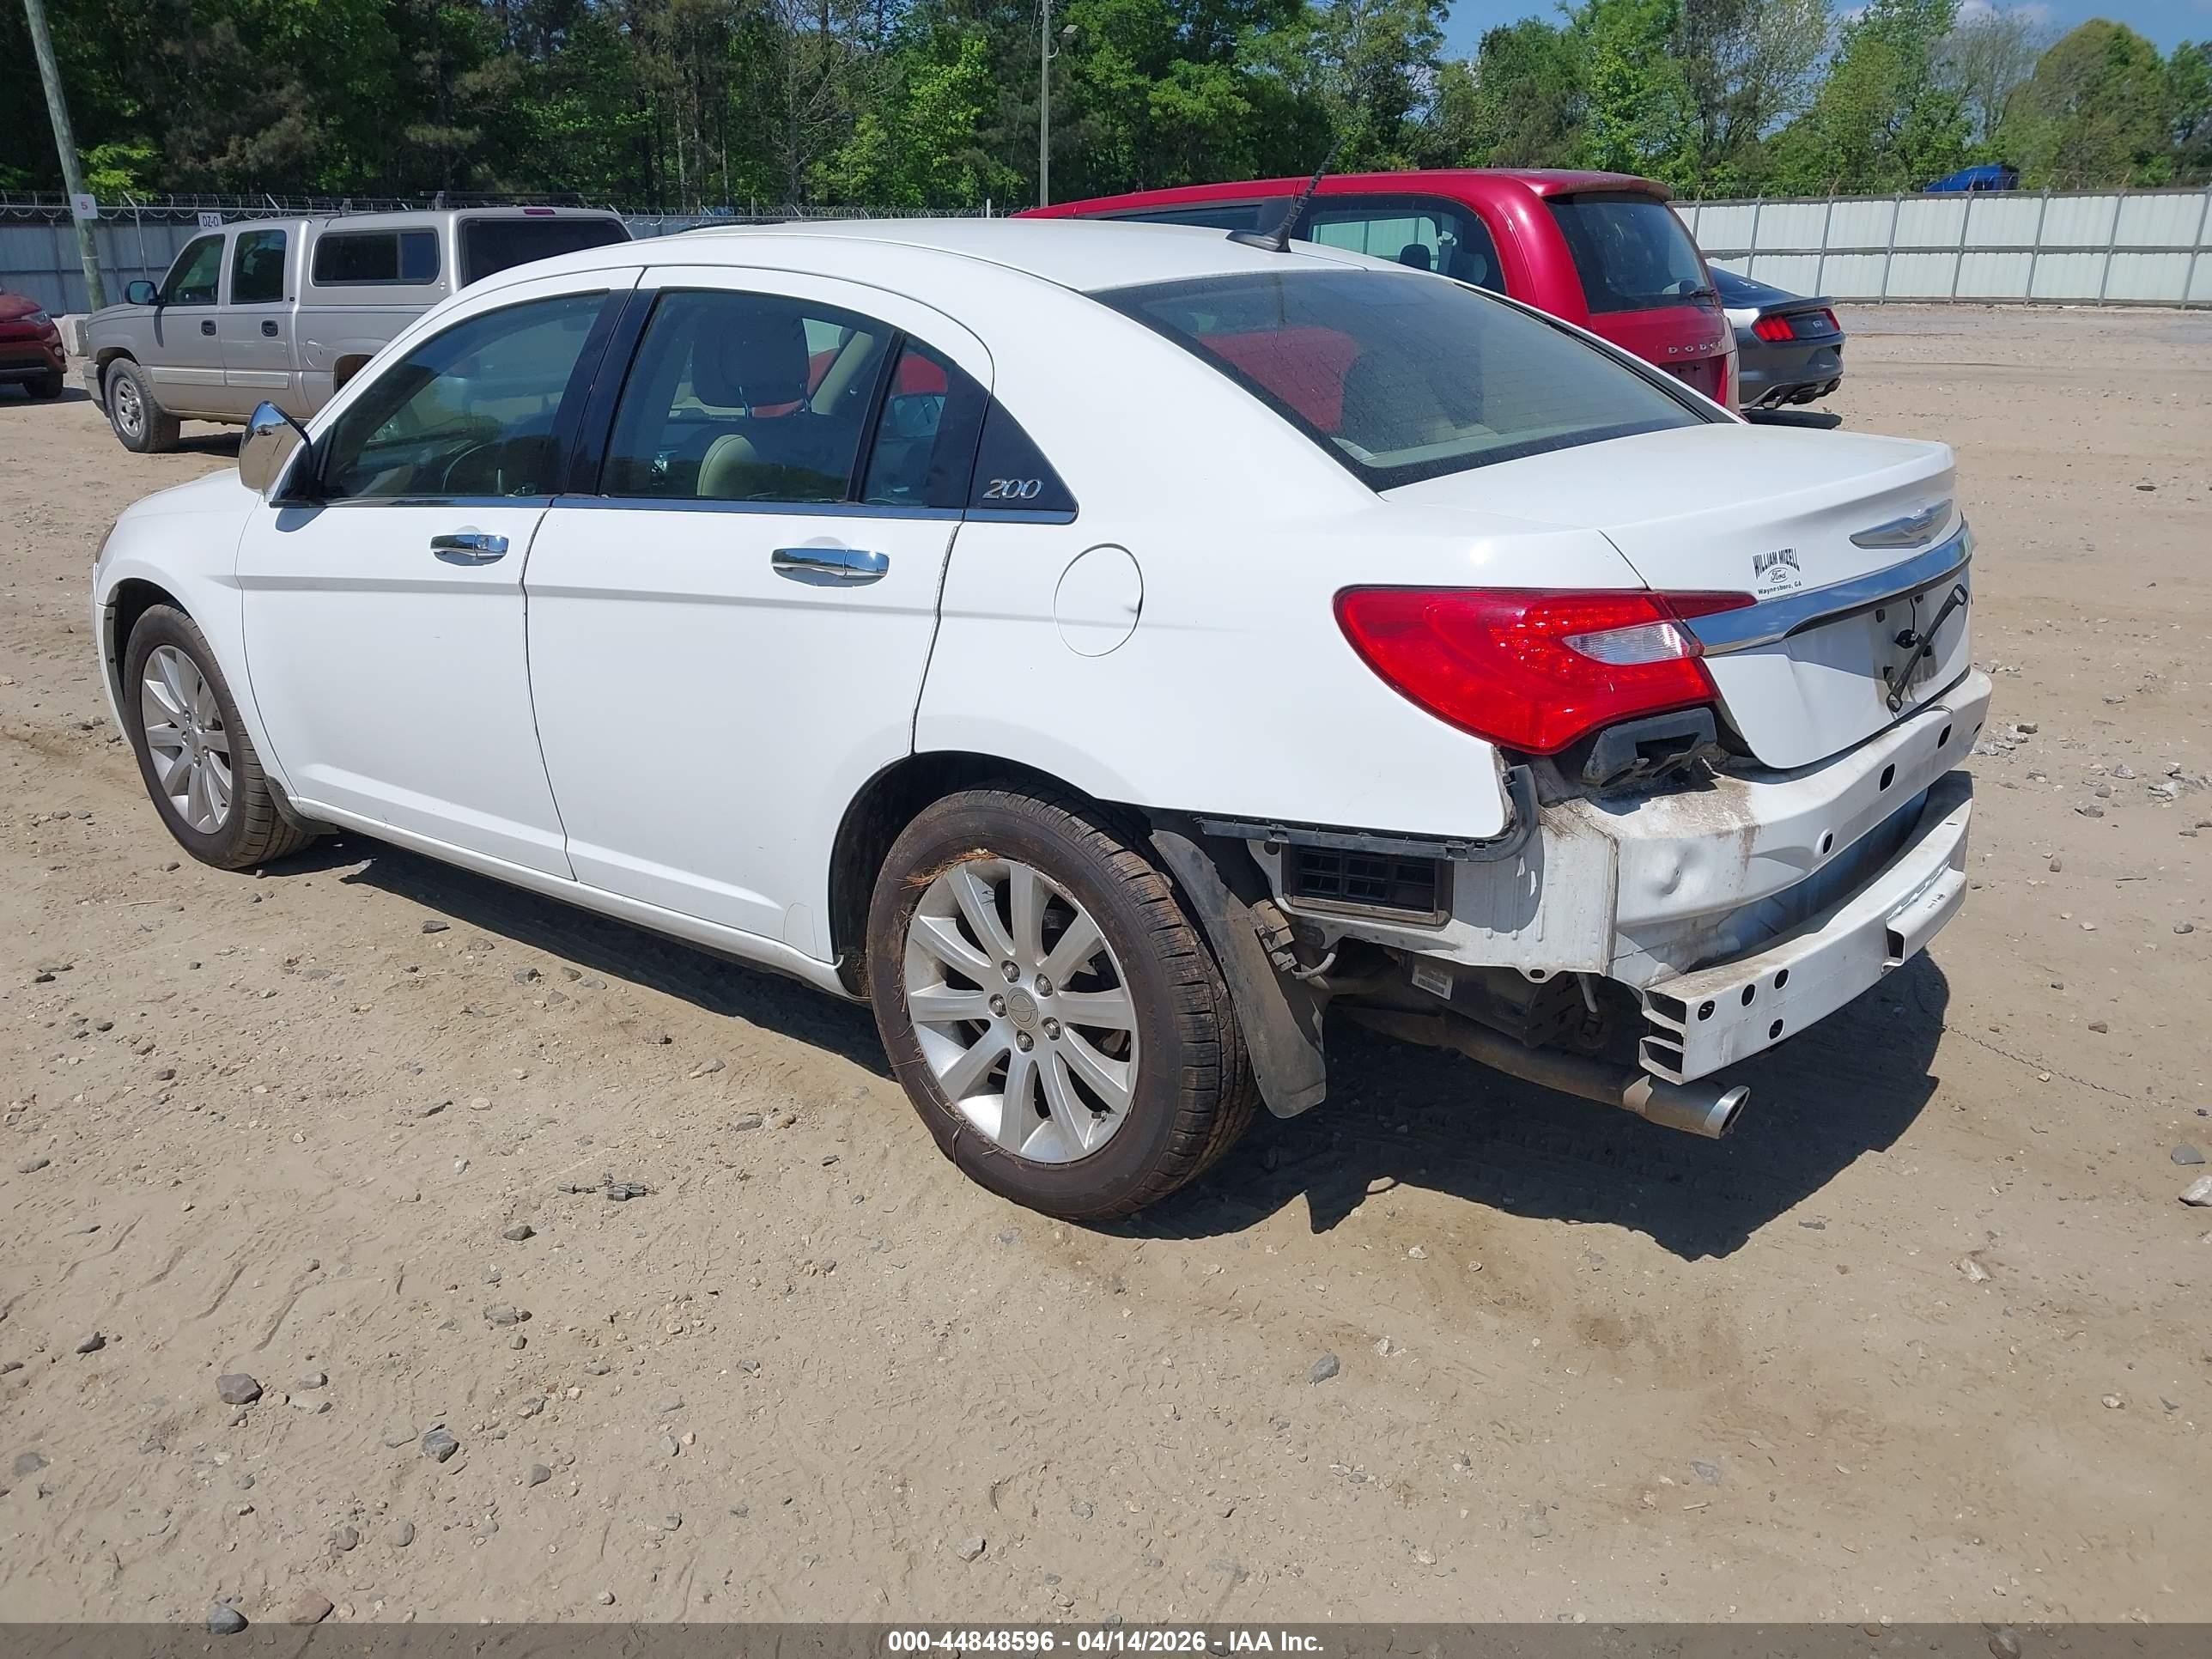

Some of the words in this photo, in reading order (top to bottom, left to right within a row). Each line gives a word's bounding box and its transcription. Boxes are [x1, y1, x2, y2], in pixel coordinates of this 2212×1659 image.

[81, 201, 88, 210] 5
[982, 479, 1042, 499] 200
[1753, 551, 1778, 580] WILLIAM
[1778, 548, 1800, 572] MIZELL
[1771, 569, 1787, 581] Ford
